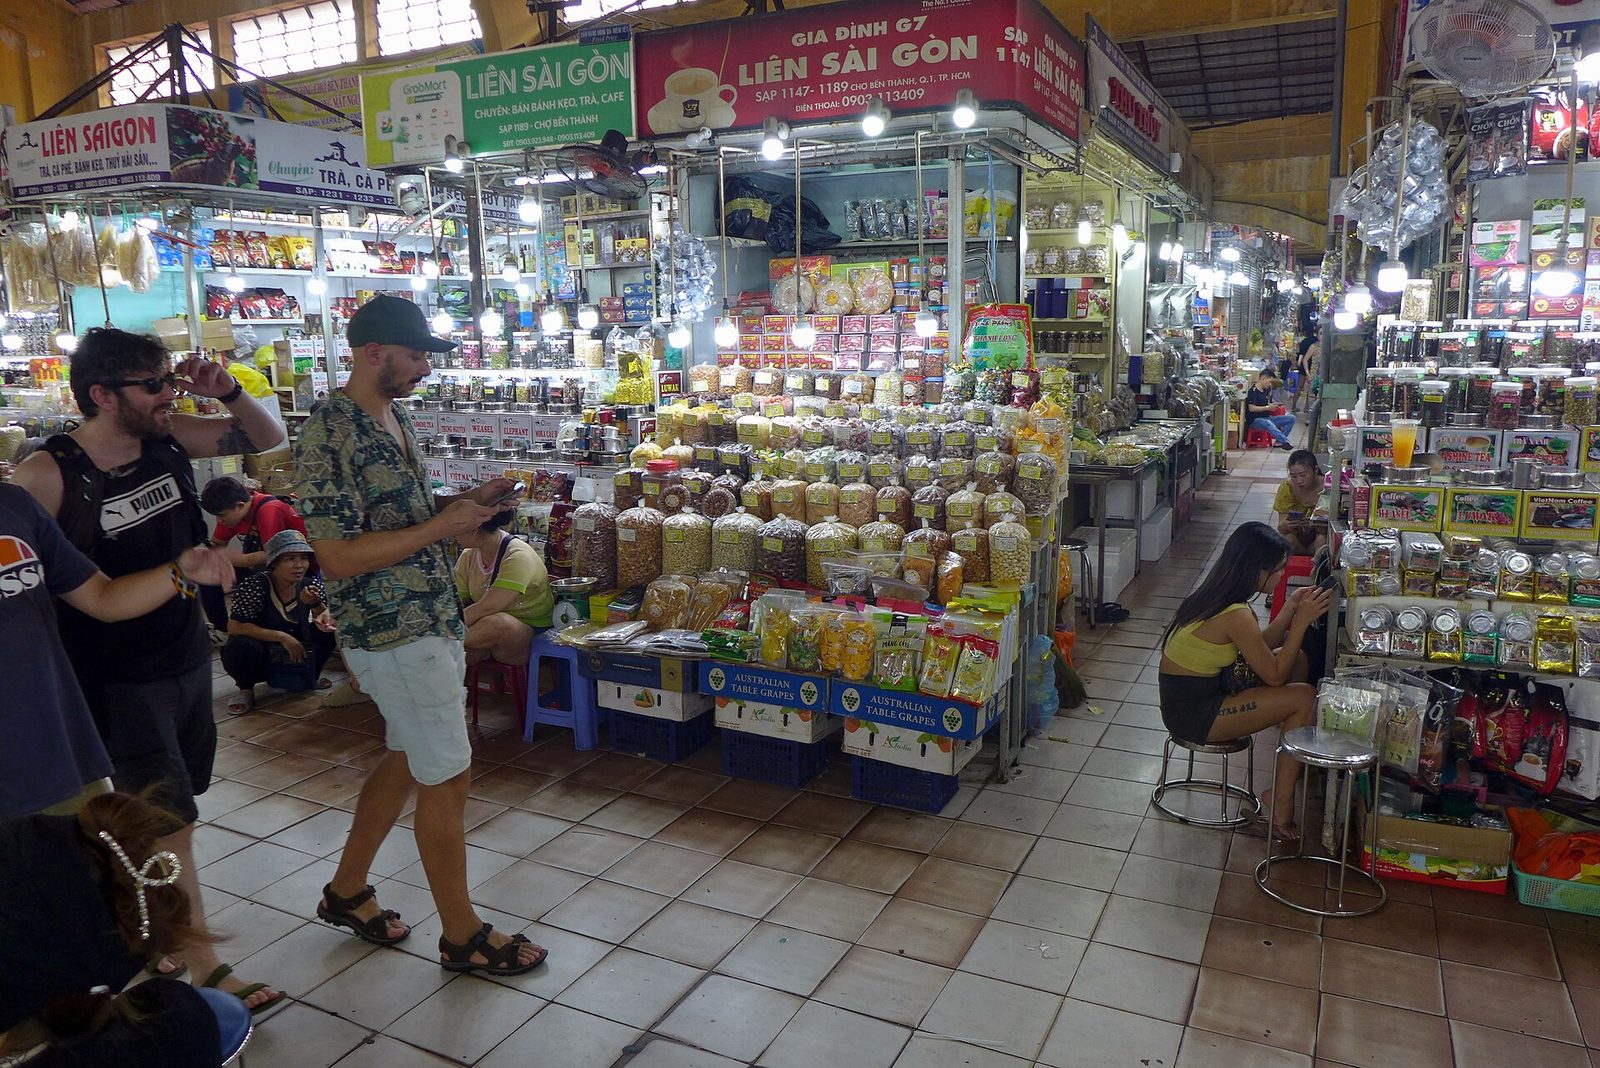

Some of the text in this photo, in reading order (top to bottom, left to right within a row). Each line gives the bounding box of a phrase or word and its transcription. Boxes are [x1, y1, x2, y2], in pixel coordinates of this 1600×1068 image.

[791, 15, 928, 47] GIA ĐÌNH G7
[1004, 26, 1028, 47] SẠP
[738, 33, 978, 87] LIÊN SÀI GÒN
[466, 49, 630, 100] LIÊN SÀI GÒN
[1034, 46, 1053, 84] LIÊN
[1054, 64, 1068, 96] SÀI
[403, 79, 447, 96] GrabMart
[755, 89, 777, 104] SẠP
[819, 81, 848, 95] 1189
[850, 82, 868, 92] CHỢ
[869, 79, 885, 89] BẾN
[887, 76, 918, 87] THÀNH,
[919, 74, 936, 84] Q.1,
[938, 73, 948, 81] TP.
[951, 71, 971, 80] HCM
[474, 91, 624, 119] CHUYÊN: BÁN BÁNH KẸO, TRÀ, CAFE
[795, 104, 813, 113] ĐIỆN
[814, 101, 840, 110] THOẠI:
[498, 113, 599, 134] SẠP 1189 CHỢ BẾN THÀNH
[41, 116, 157, 158] LIÊN SAIGON
[268, 160, 314, 178] Chuyên:
[318, 168, 351, 187] TRÀ,
[356, 173, 373, 190] CÀ
[320, 189, 343, 199] 1231
[353, 193, 374, 203] 1233
[472, 424, 494, 434] WEASEL
[503, 427, 529, 437] ELEPHANT
[1364, 448, 1394, 458] LOTUS
[1475, 452, 1491, 463] TEA
[129, 482, 174, 515] PUMA
[1380, 491, 1406, 501] Coffee
[1454, 494, 1479, 502] Coffee
[1533, 497, 1593, 506] VietNam Coffee
[734, 673, 791, 689] AUSTRALIAN
[730, 683, 795, 701] TABLE GRAPES
[869, 695, 933, 714] AUSTRALIAN
[865, 706, 936, 727] TABLE GRAPES
